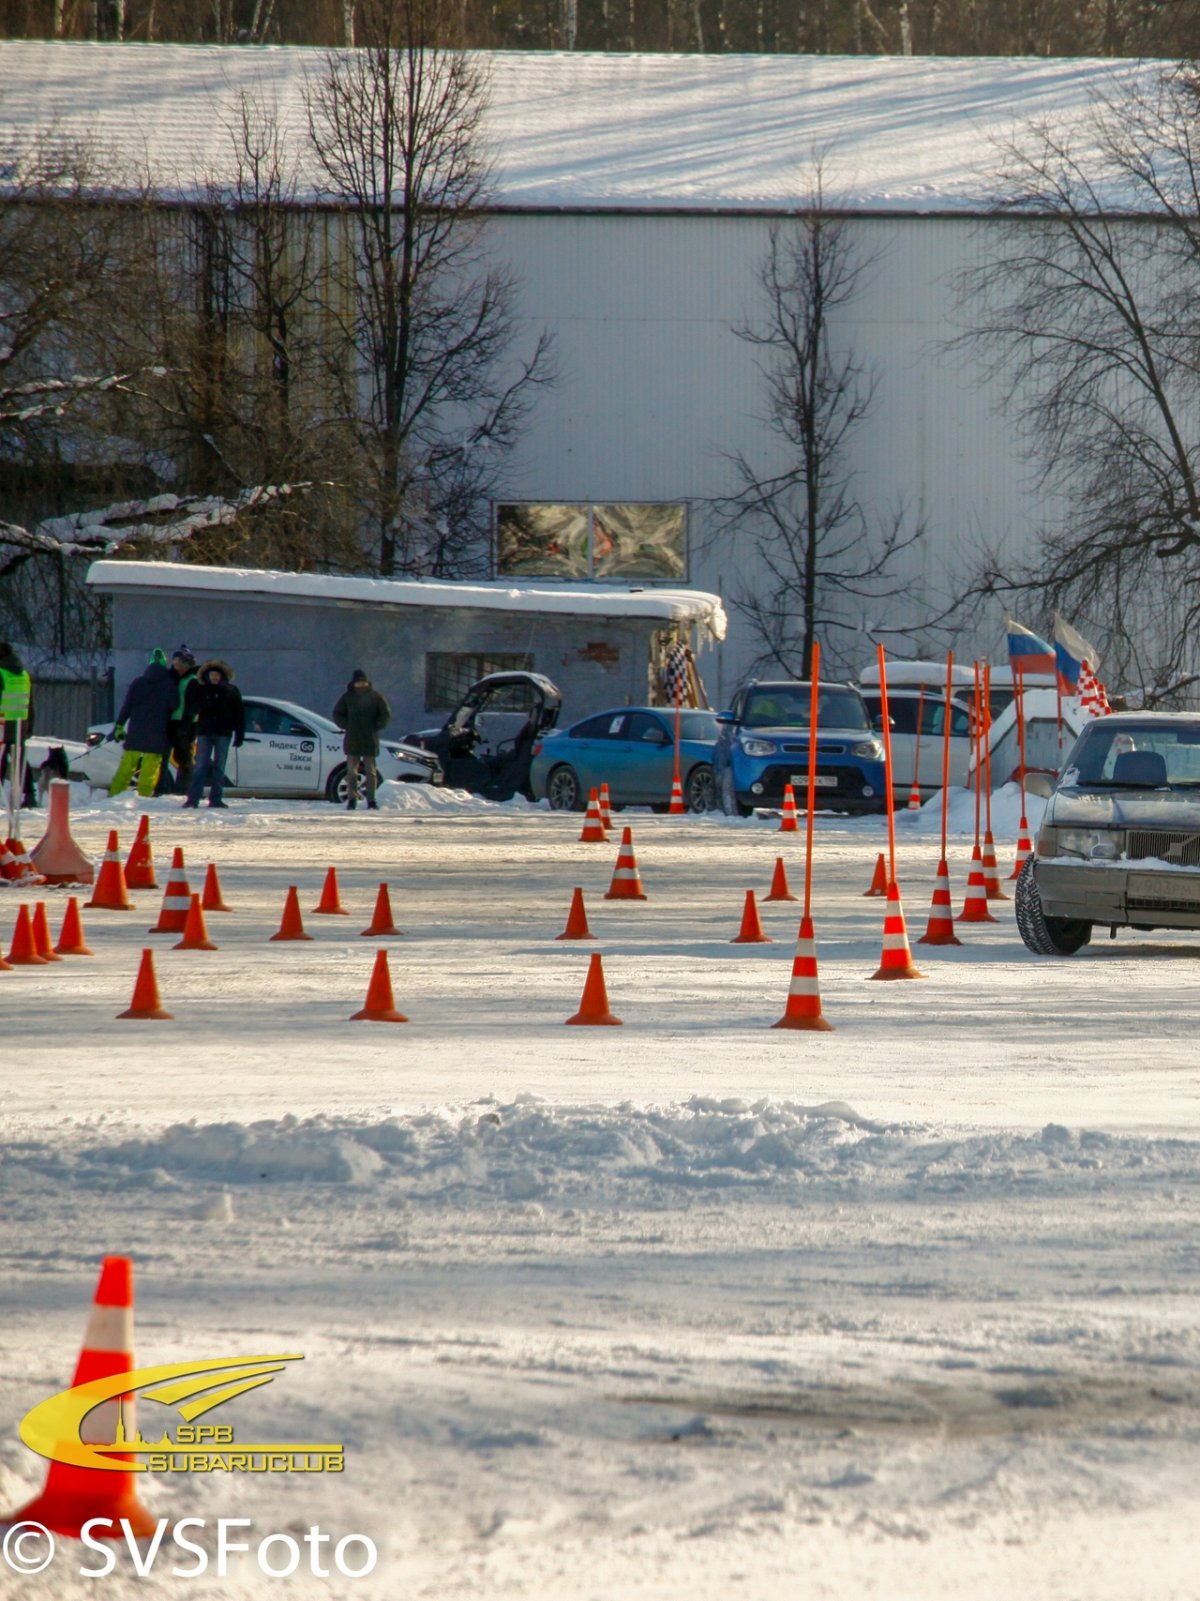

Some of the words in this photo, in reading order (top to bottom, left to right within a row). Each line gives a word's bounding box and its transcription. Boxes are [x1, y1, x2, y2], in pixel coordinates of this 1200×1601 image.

[269, 740, 299, 750] Яндекс
[301, 742, 313, 752] Go
[289, 752, 312, 762] Такси
